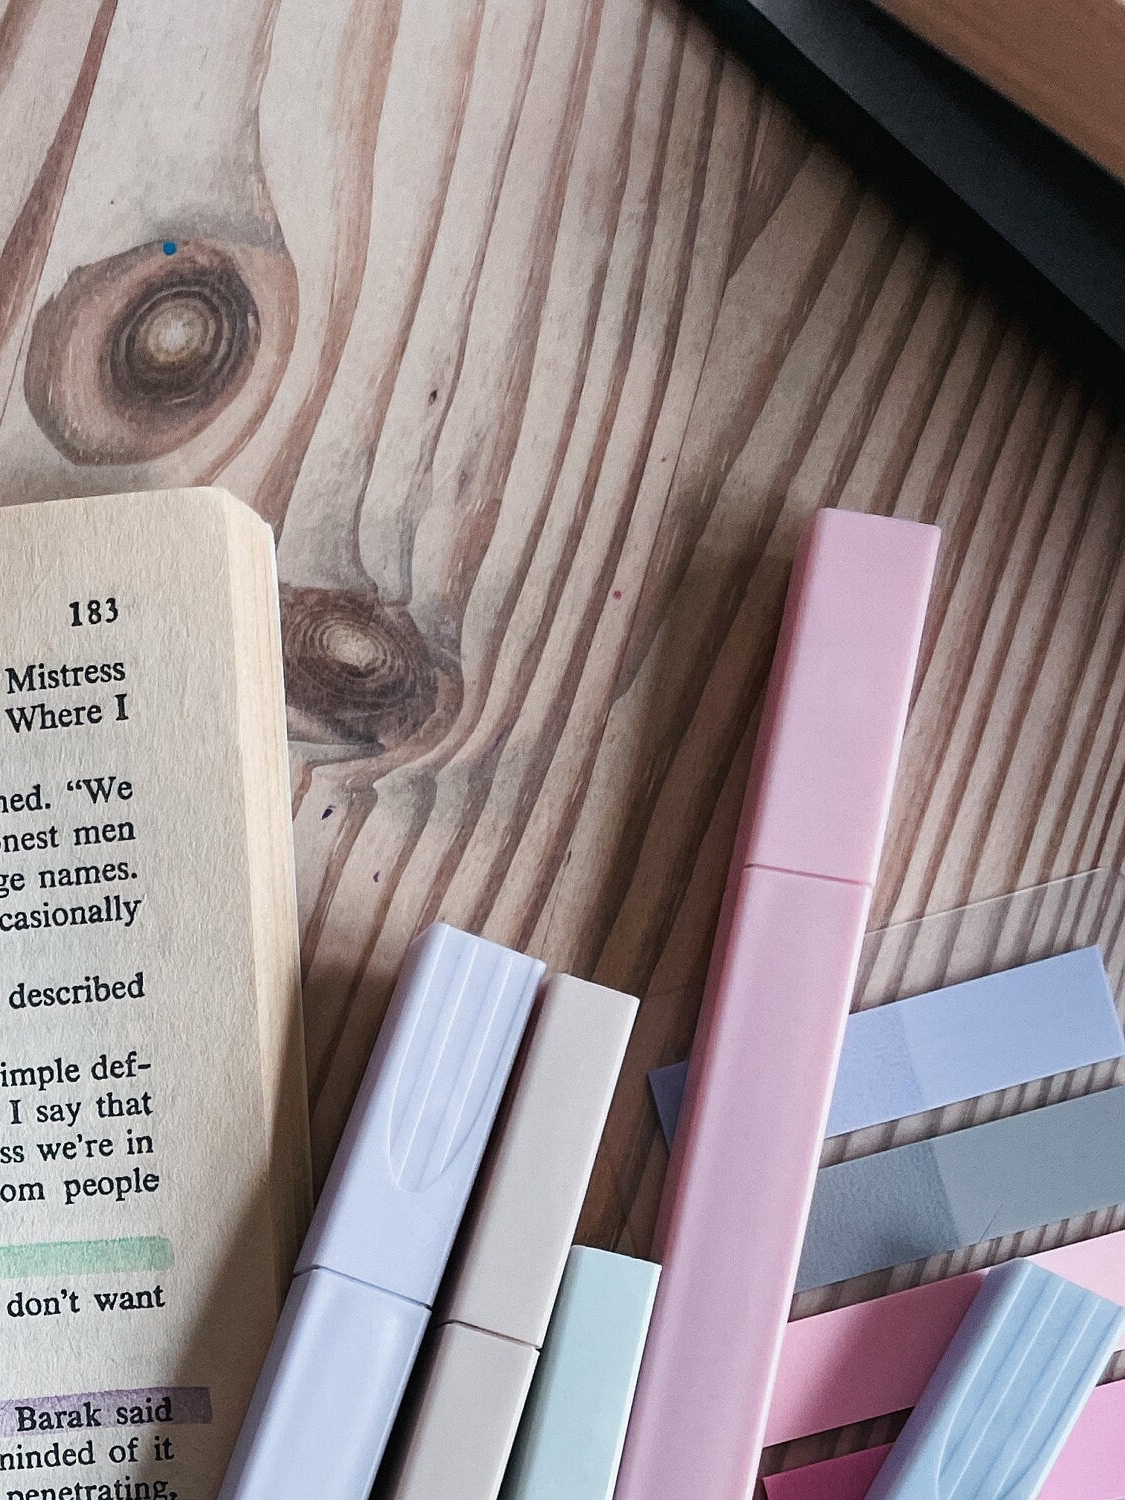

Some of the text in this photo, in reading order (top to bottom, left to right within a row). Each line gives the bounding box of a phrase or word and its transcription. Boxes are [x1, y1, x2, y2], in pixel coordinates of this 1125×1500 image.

[68, 597, 119, 628] 183
[4, 662, 126, 695] Mistress
[37, 861, 138, 889] names.
[90, 1050, 152, 1081] def-
